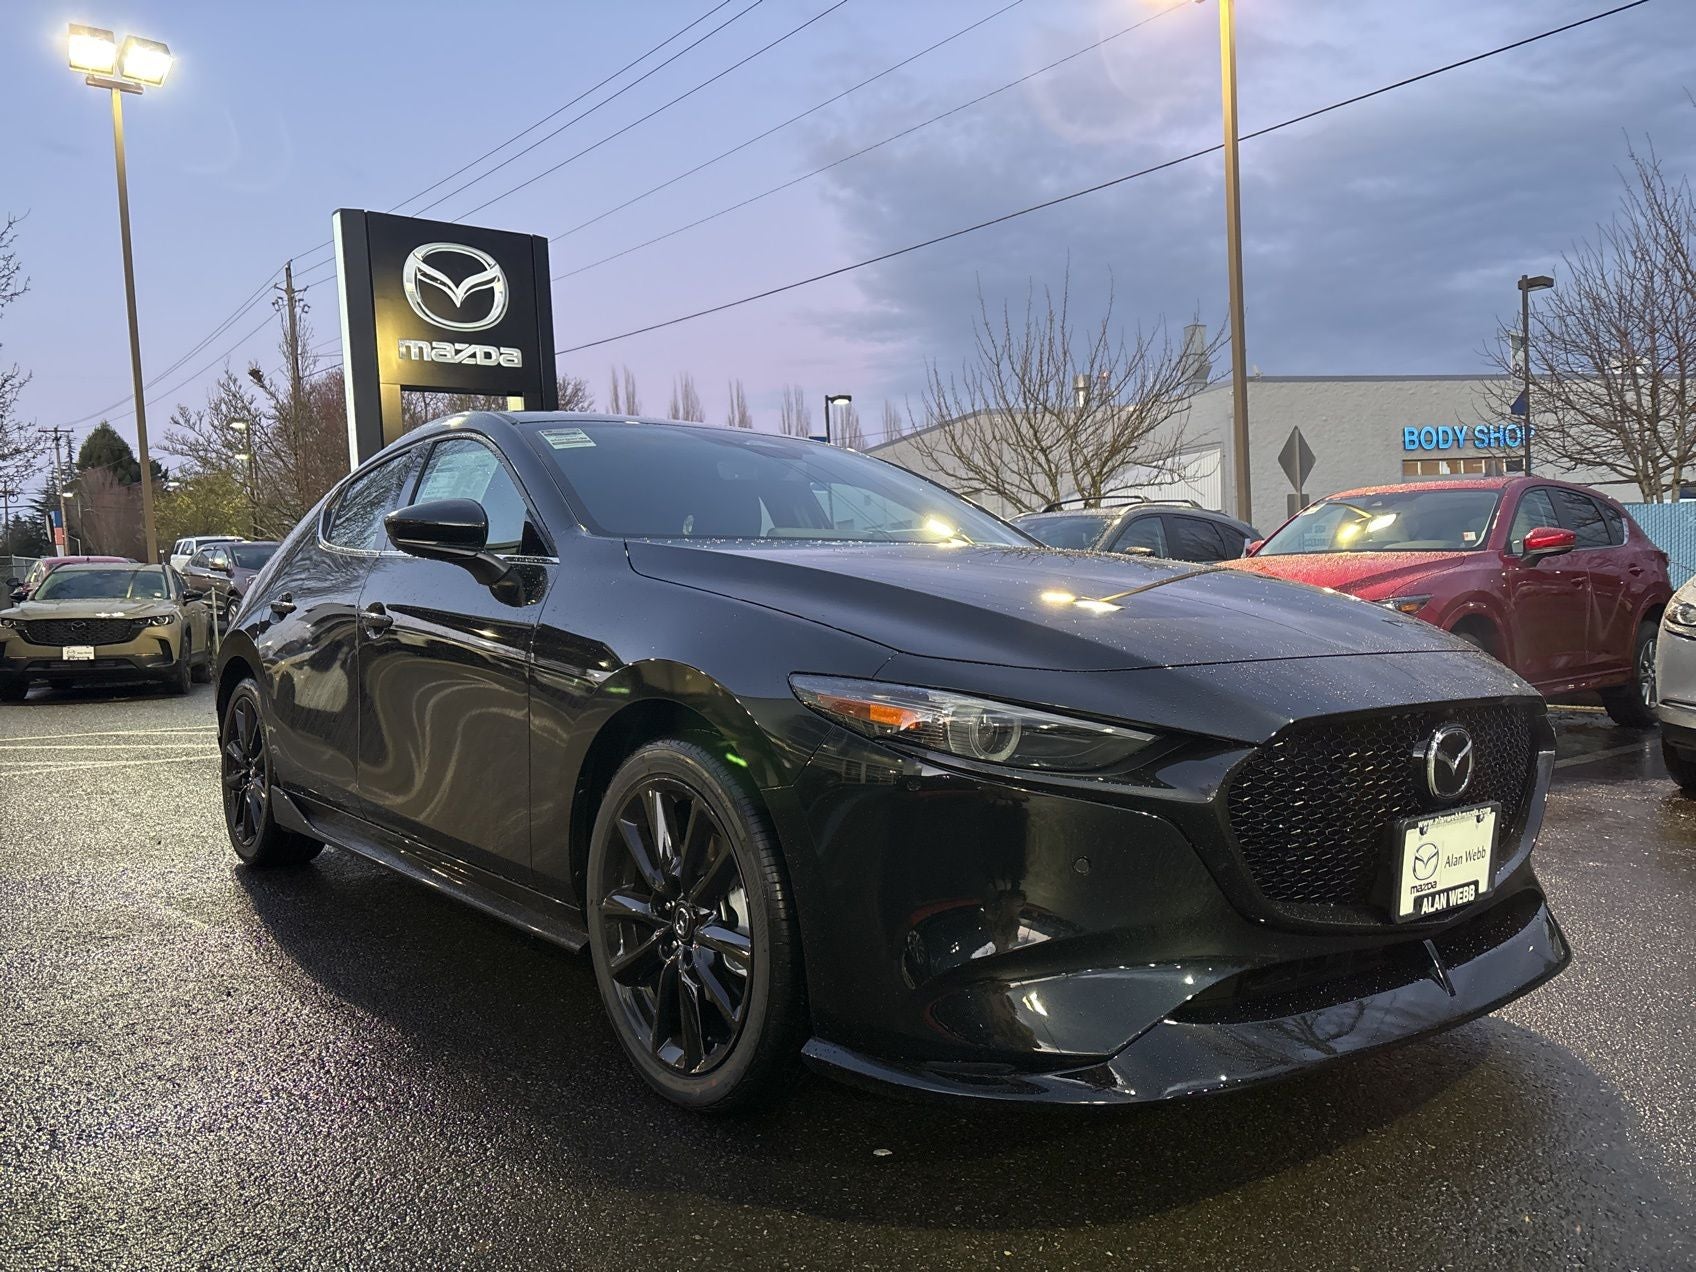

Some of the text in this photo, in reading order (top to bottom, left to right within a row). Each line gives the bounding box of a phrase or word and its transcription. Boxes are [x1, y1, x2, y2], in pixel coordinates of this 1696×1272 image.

[1403, 424, 1467, 450] BODY
[1444, 845, 1487, 869] Alan Webb
[1421, 884, 1476, 915] ALAN WEBB
